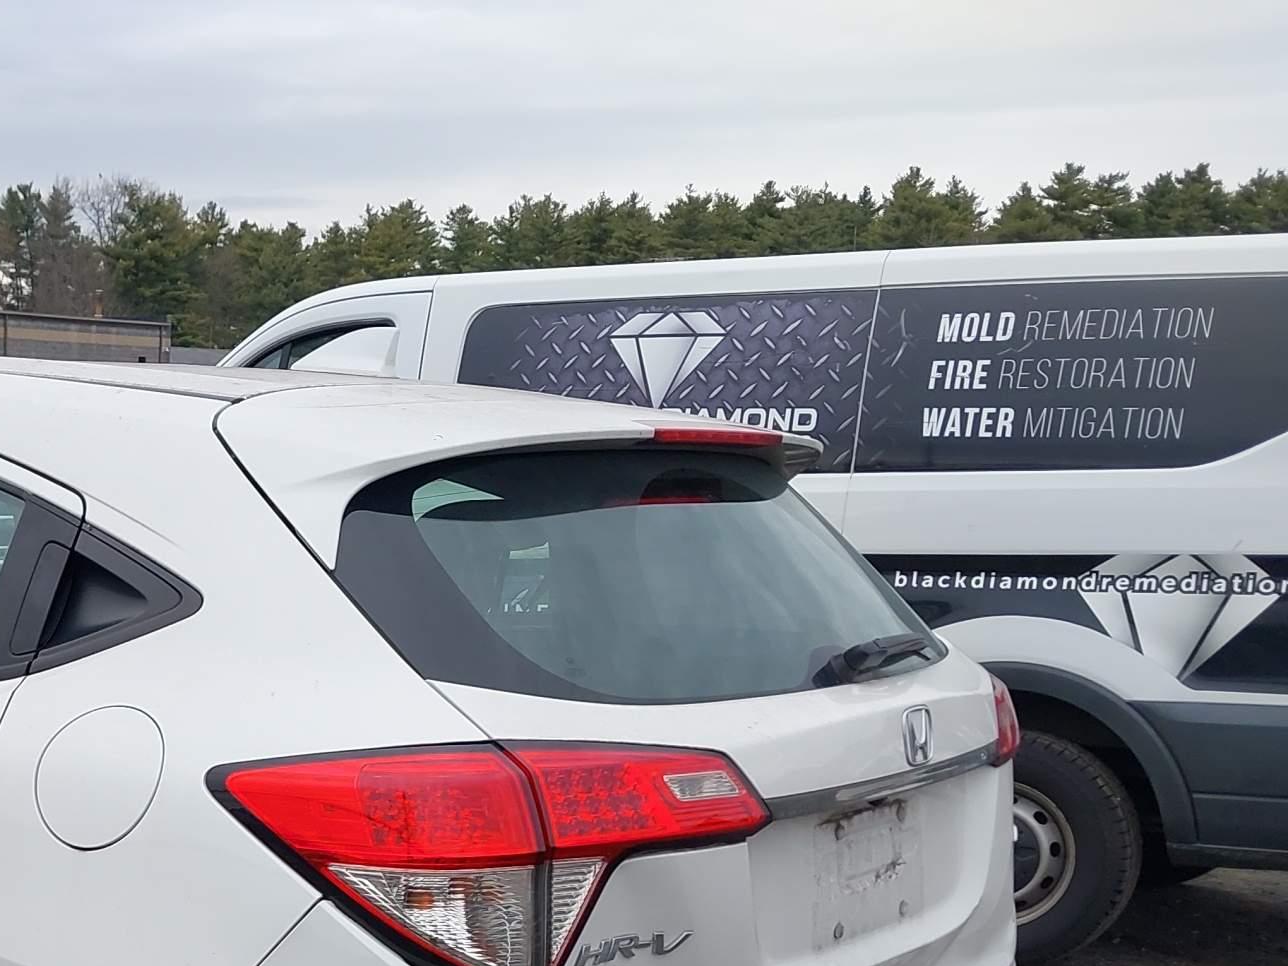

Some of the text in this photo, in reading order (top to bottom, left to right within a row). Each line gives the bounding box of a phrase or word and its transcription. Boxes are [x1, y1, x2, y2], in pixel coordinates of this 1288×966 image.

[937, 308, 1214, 342] MOLD REMEDIATION
[928, 358, 1196, 390] FIRE RESTORATION
[664, 408, 818, 432] MOND
[922, 408, 1184, 439] WATER MITIGATION
